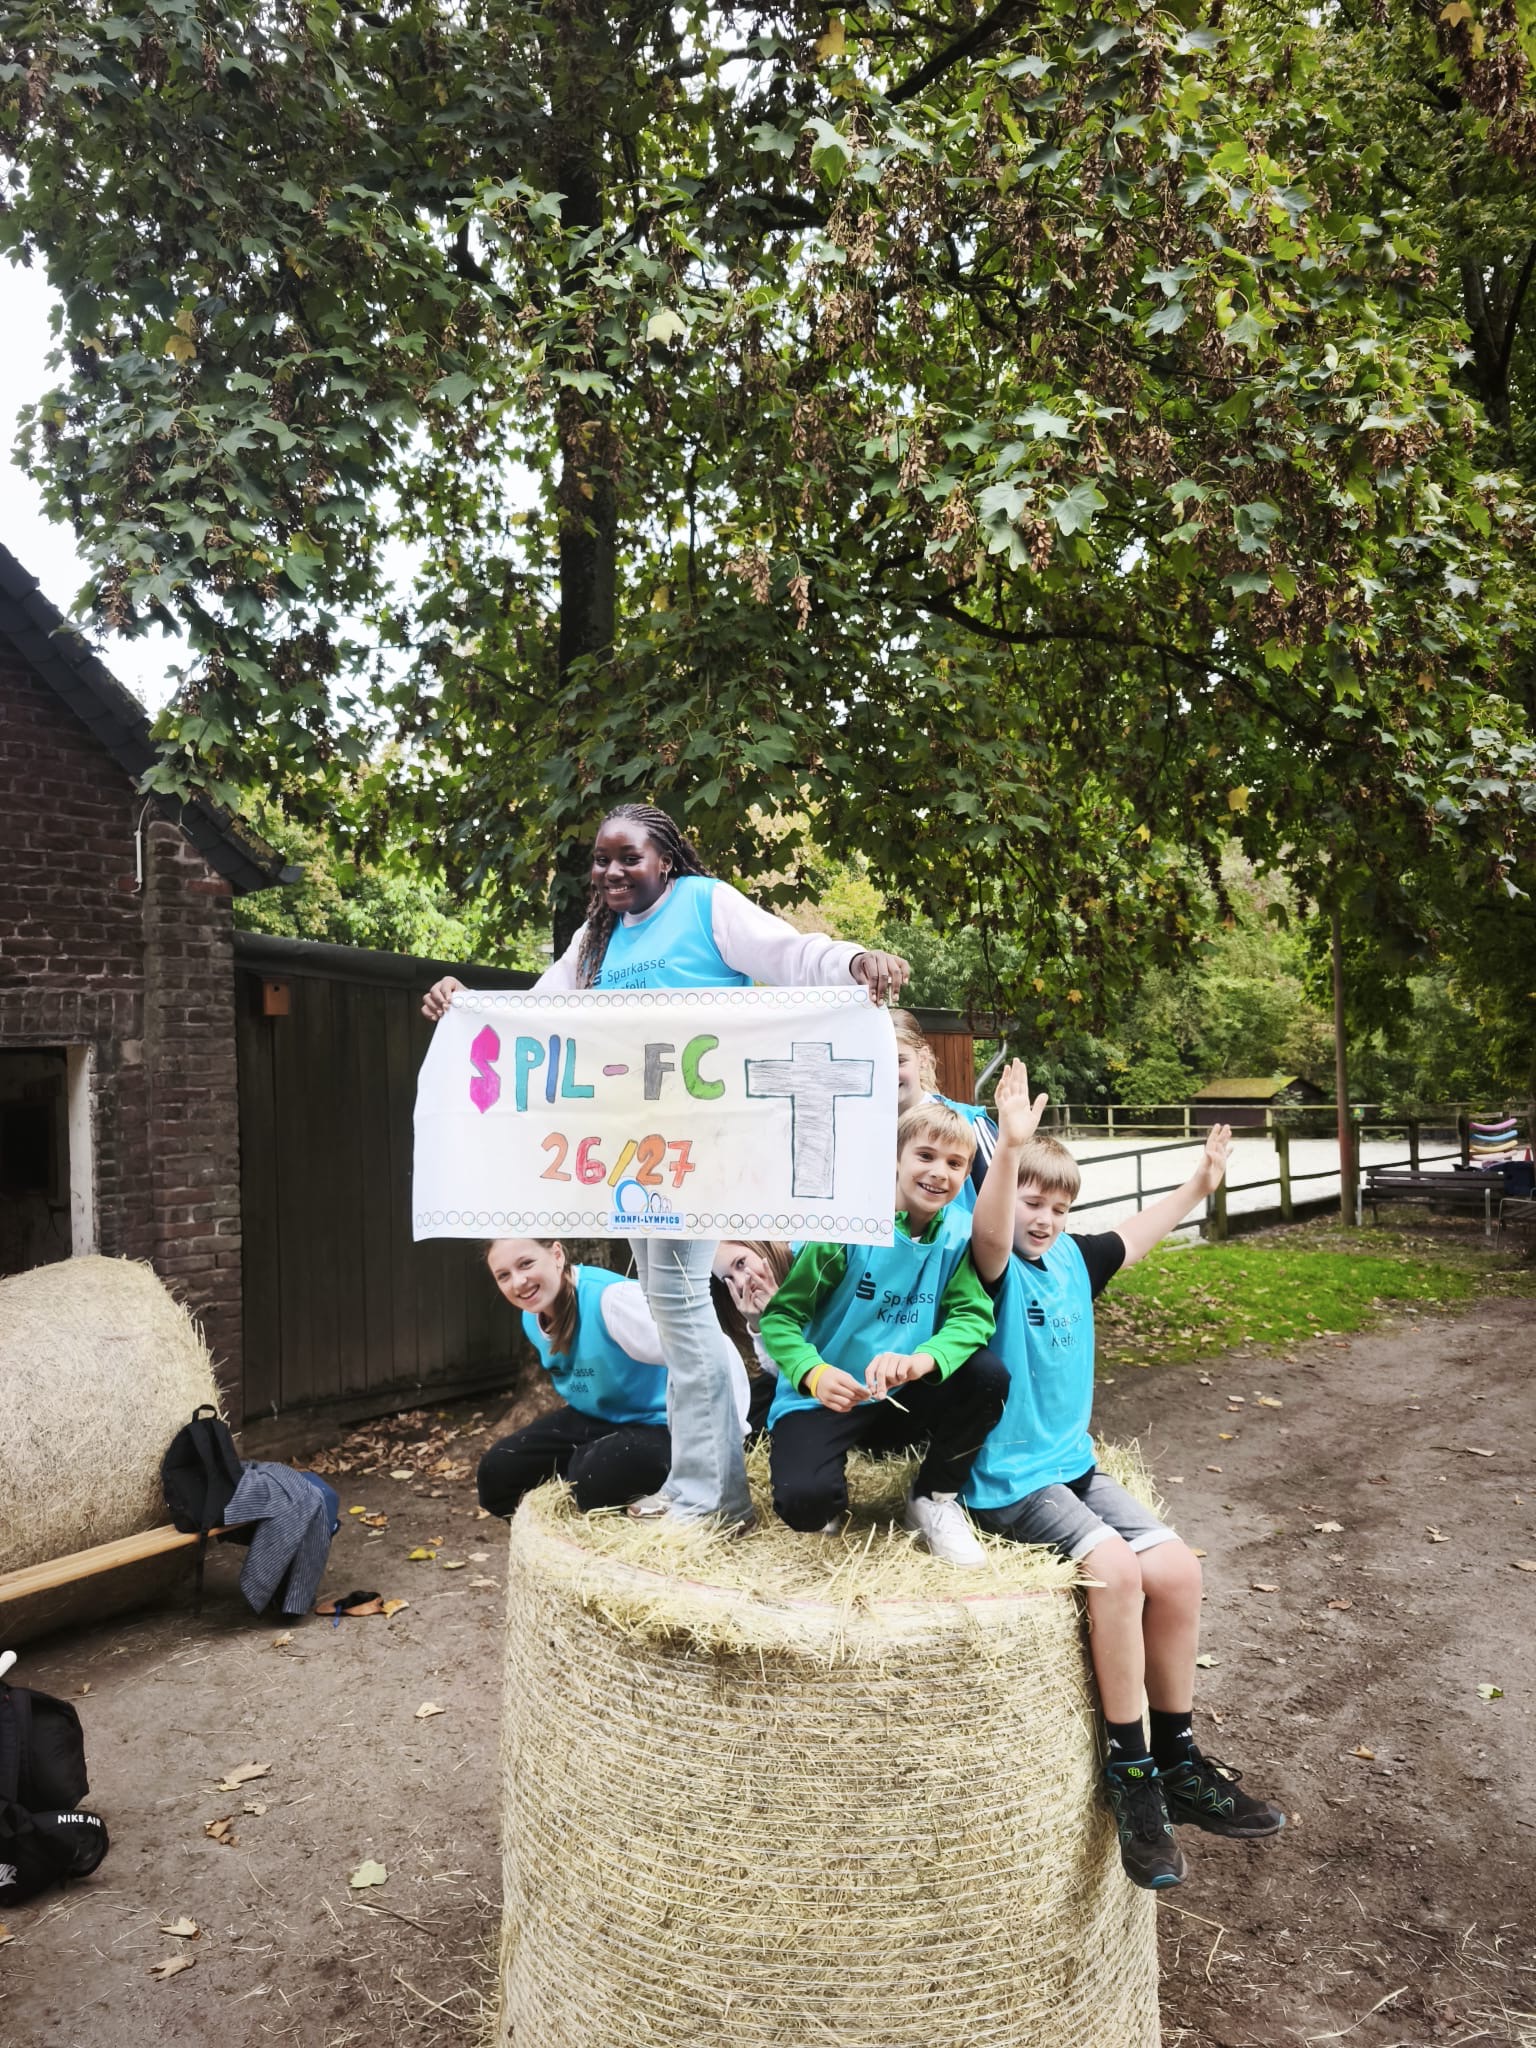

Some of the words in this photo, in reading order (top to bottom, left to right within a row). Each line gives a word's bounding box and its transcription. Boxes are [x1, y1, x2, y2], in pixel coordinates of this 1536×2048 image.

[607, 958, 666, 984] Sparkasse
[469, 1023, 726, 1114] SPIL-FC
[539, 1131, 697, 1188] 26/27
[614, 1215, 680, 1225] KONFI-LYMPICS
[876, 1308, 919, 1325] Krfeld
[57, 1814, 84, 1824] NIKE
